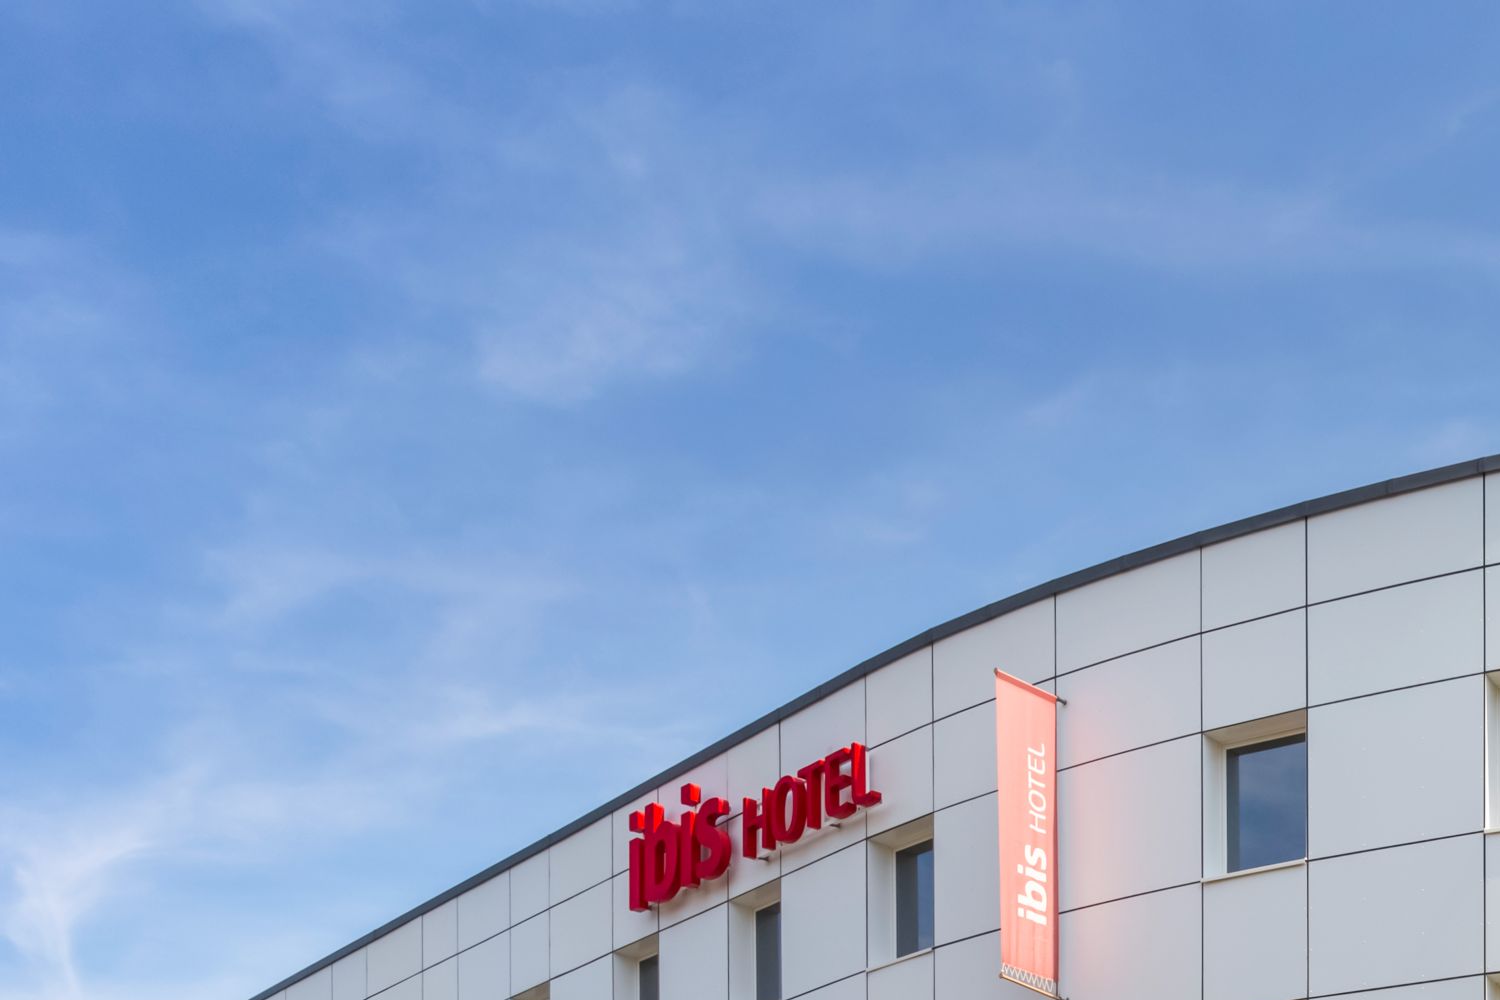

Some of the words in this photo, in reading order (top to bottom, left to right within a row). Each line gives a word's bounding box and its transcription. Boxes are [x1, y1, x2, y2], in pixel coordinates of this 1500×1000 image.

[629, 783, 732, 912] ibis
[743, 742, 882, 859] HOTEL
[1027, 743, 1046, 834] HOTEL
[1017, 845, 1047, 926] ibis
